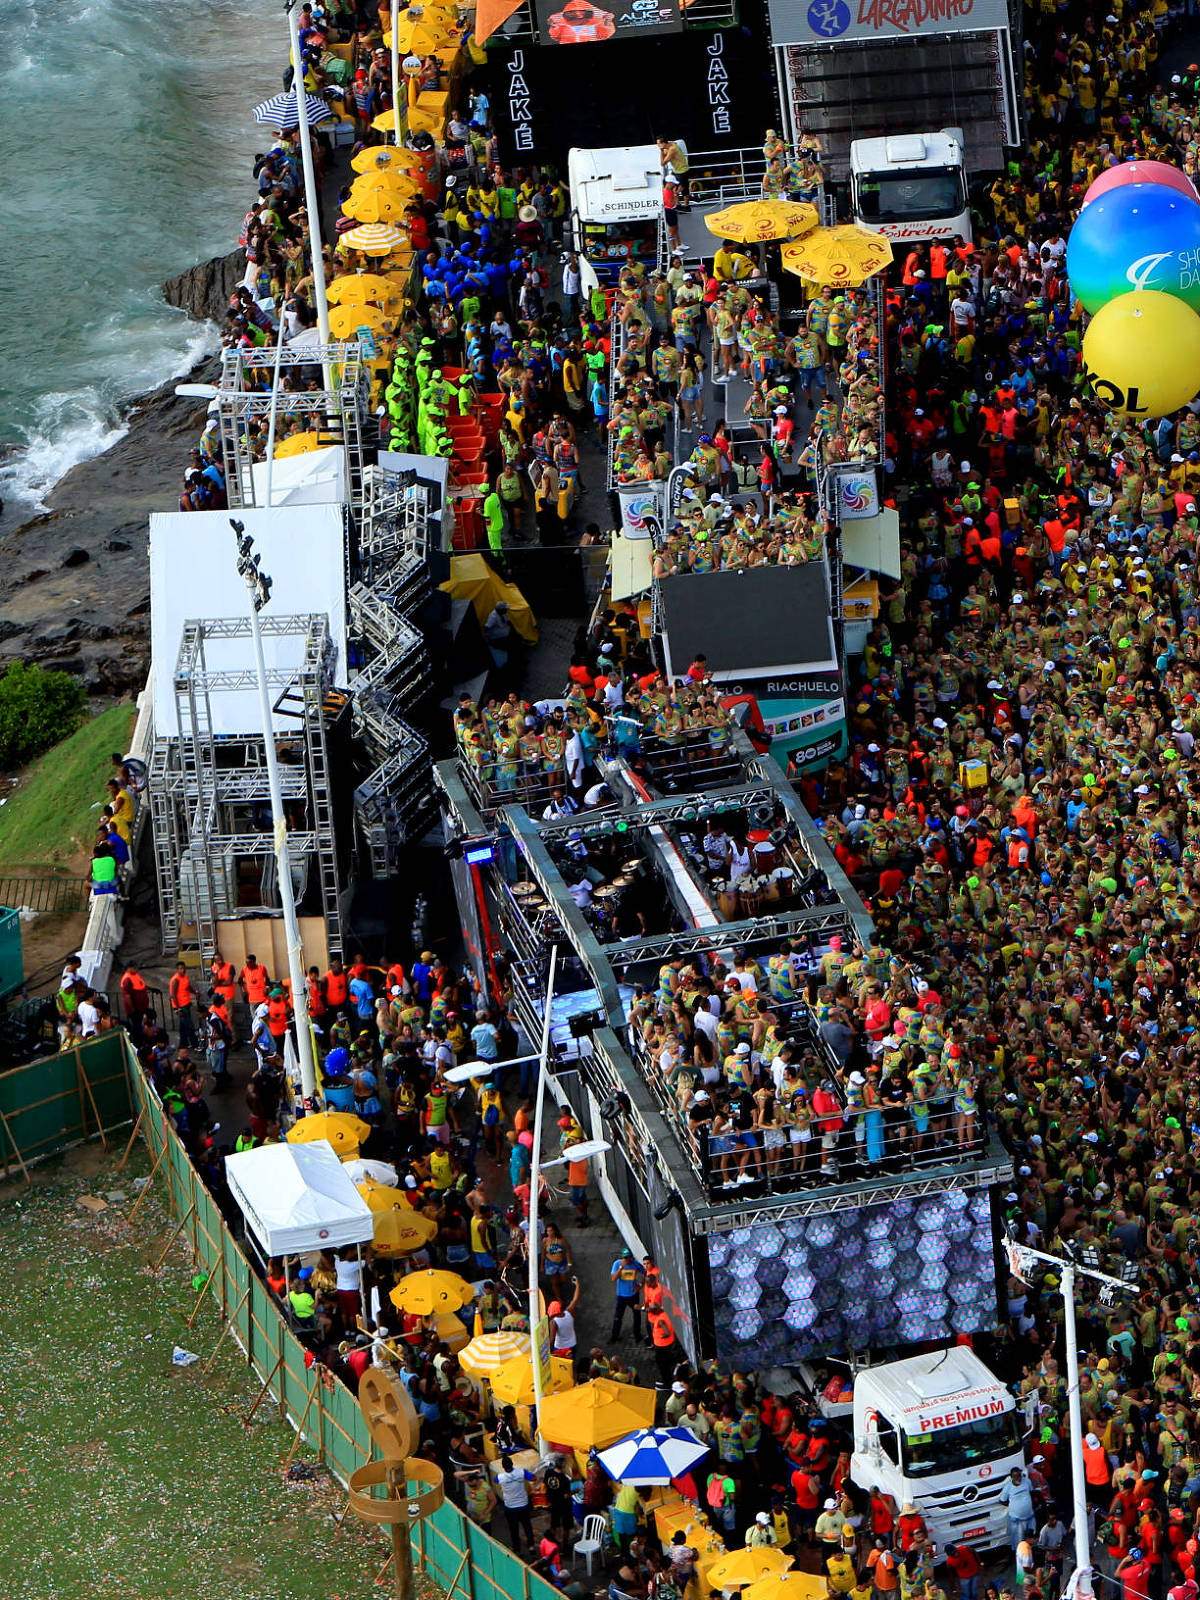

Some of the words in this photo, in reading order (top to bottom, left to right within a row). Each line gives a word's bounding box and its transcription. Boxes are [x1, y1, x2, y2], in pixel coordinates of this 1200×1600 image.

[707, 33, 731, 133] JAKÉ
[508, 50, 534, 150] JAKÉ
[605, 200, 659, 210] SCHINDLER
[1179, 271, 1200, 289] DA
[767, 681, 839, 693] RIACHUELO
[920, 1400, 1005, 1432] PREMIUM
